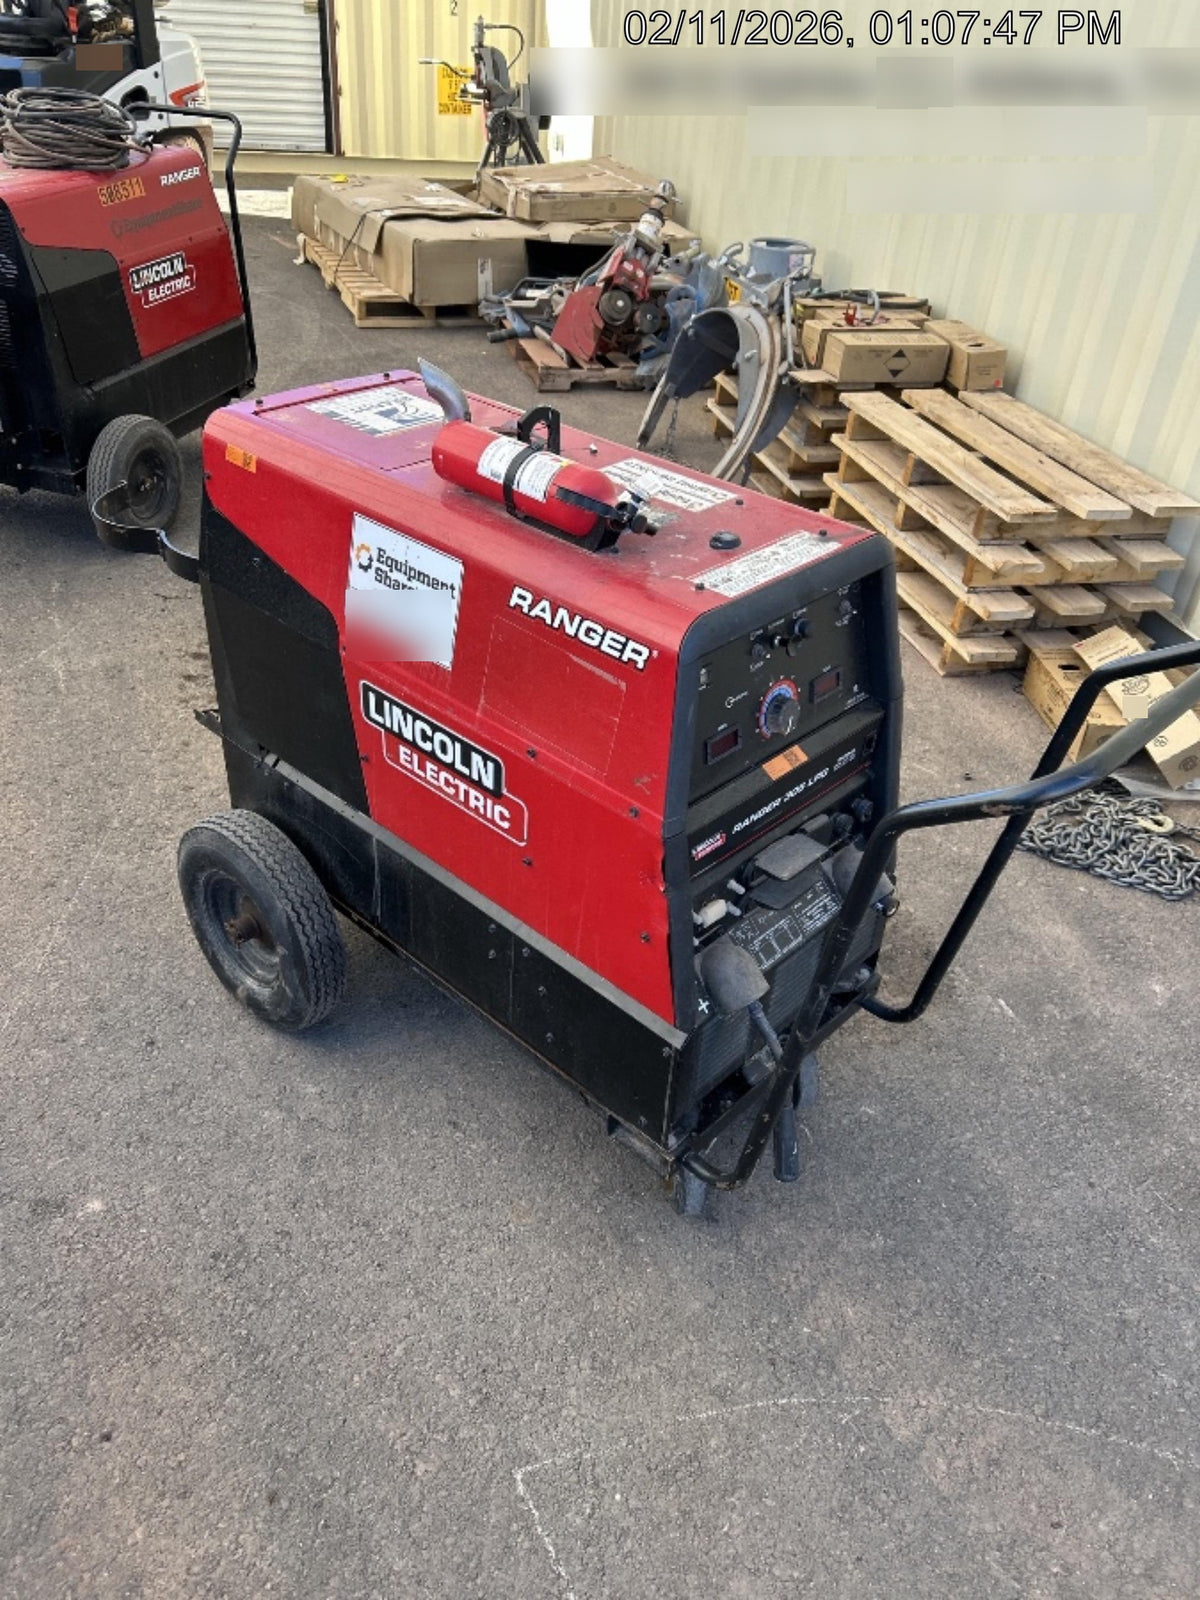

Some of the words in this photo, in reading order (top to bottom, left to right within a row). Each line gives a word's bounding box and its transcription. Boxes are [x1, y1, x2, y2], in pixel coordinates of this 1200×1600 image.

[160, 166, 201, 187] RANGER
[132, 257, 184, 289] LINCOLN
[148, 275, 191, 301] ELECTRIC
[374, 567, 418, 590] Shar
[376, 547, 456, 600] Equipment
[508, 585, 651, 670] RANGER
[368, 690, 496, 790] LINCOLN
[398, 744, 511, 830] ELECTRIC
